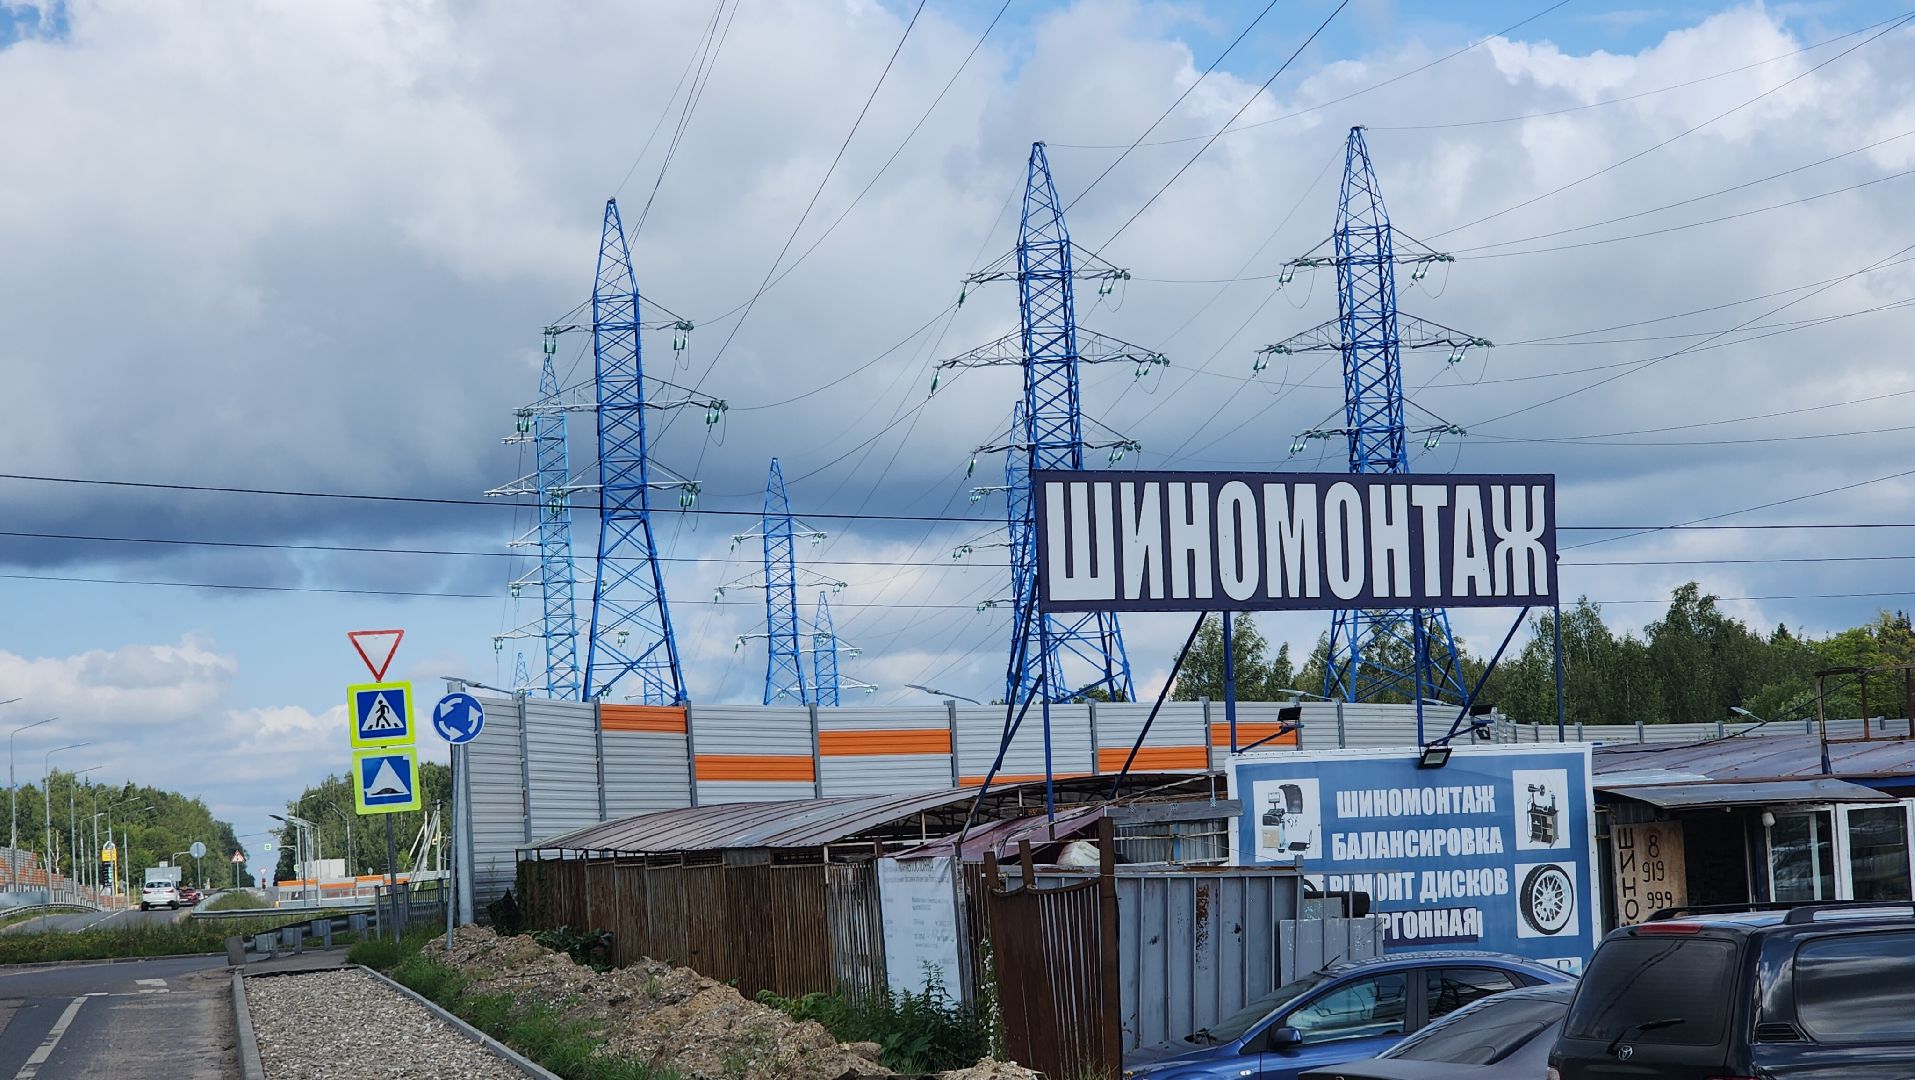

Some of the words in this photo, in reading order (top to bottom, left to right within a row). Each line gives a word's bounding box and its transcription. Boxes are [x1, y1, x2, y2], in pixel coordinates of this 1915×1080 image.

[1045, 480, 1549, 601] ШИНОМОНТАЖ
[1336, 785, 1496, 818] ШИНОМОНТАЖ
[1332, 827, 1503, 861] БАЛАНСИРОВКА
[1648, 834, 1659, 858] 8
[1420, 868, 1508, 903] ДИСКОВ
[1618, 828, 1640, 926] ШИНО
[1642, 861, 1665, 882] 919
[1647, 891, 1673, 909] 999
[1365, 907, 1478, 939] РГОННАЯ
